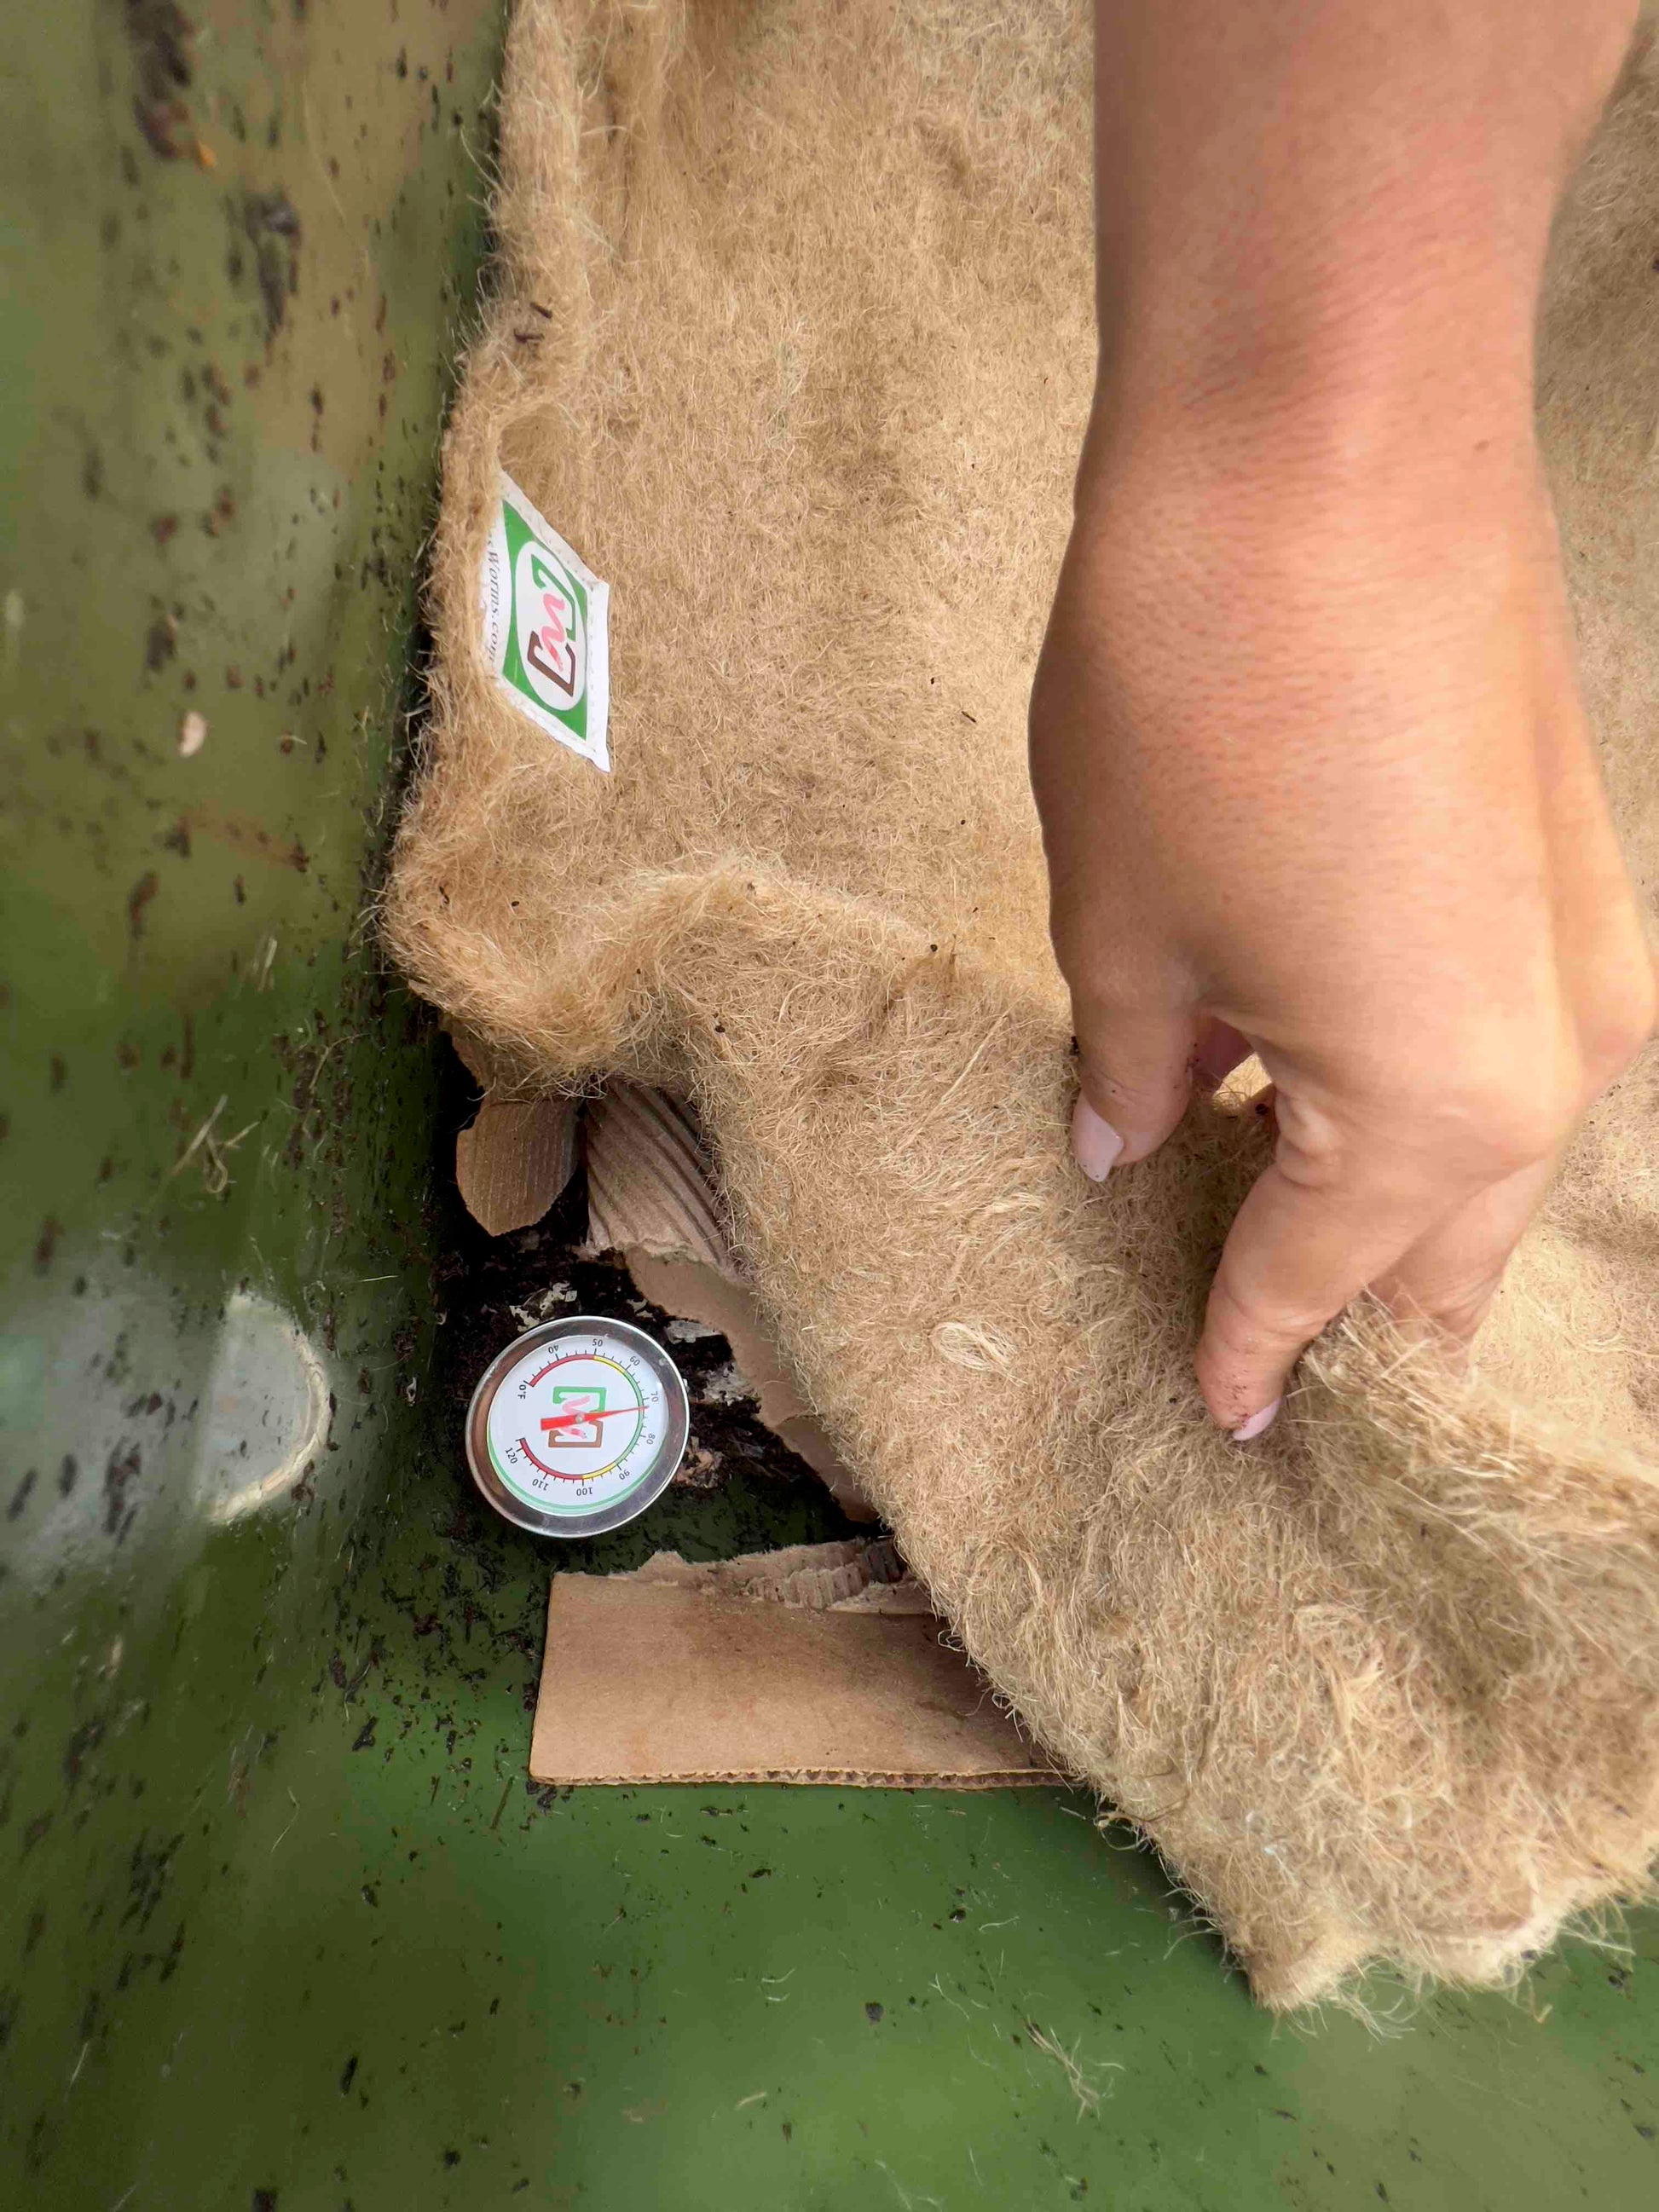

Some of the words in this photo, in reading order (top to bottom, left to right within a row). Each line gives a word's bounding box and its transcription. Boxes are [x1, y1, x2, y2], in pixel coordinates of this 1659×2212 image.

[592, 1338, 604, 1347] 50
[547, 1344, 559, 1354] 40
[629, 1355, 640, 1366] 60
[650, 1390, 659, 1402] 70
[646, 1433, 656, 1445] 80
[505, 1447, 518, 1464] 120
[618, 1469, 630, 1480] 90
[532, 1478, 549, 1491] 110
[575, 1487, 593, 1496] 100
